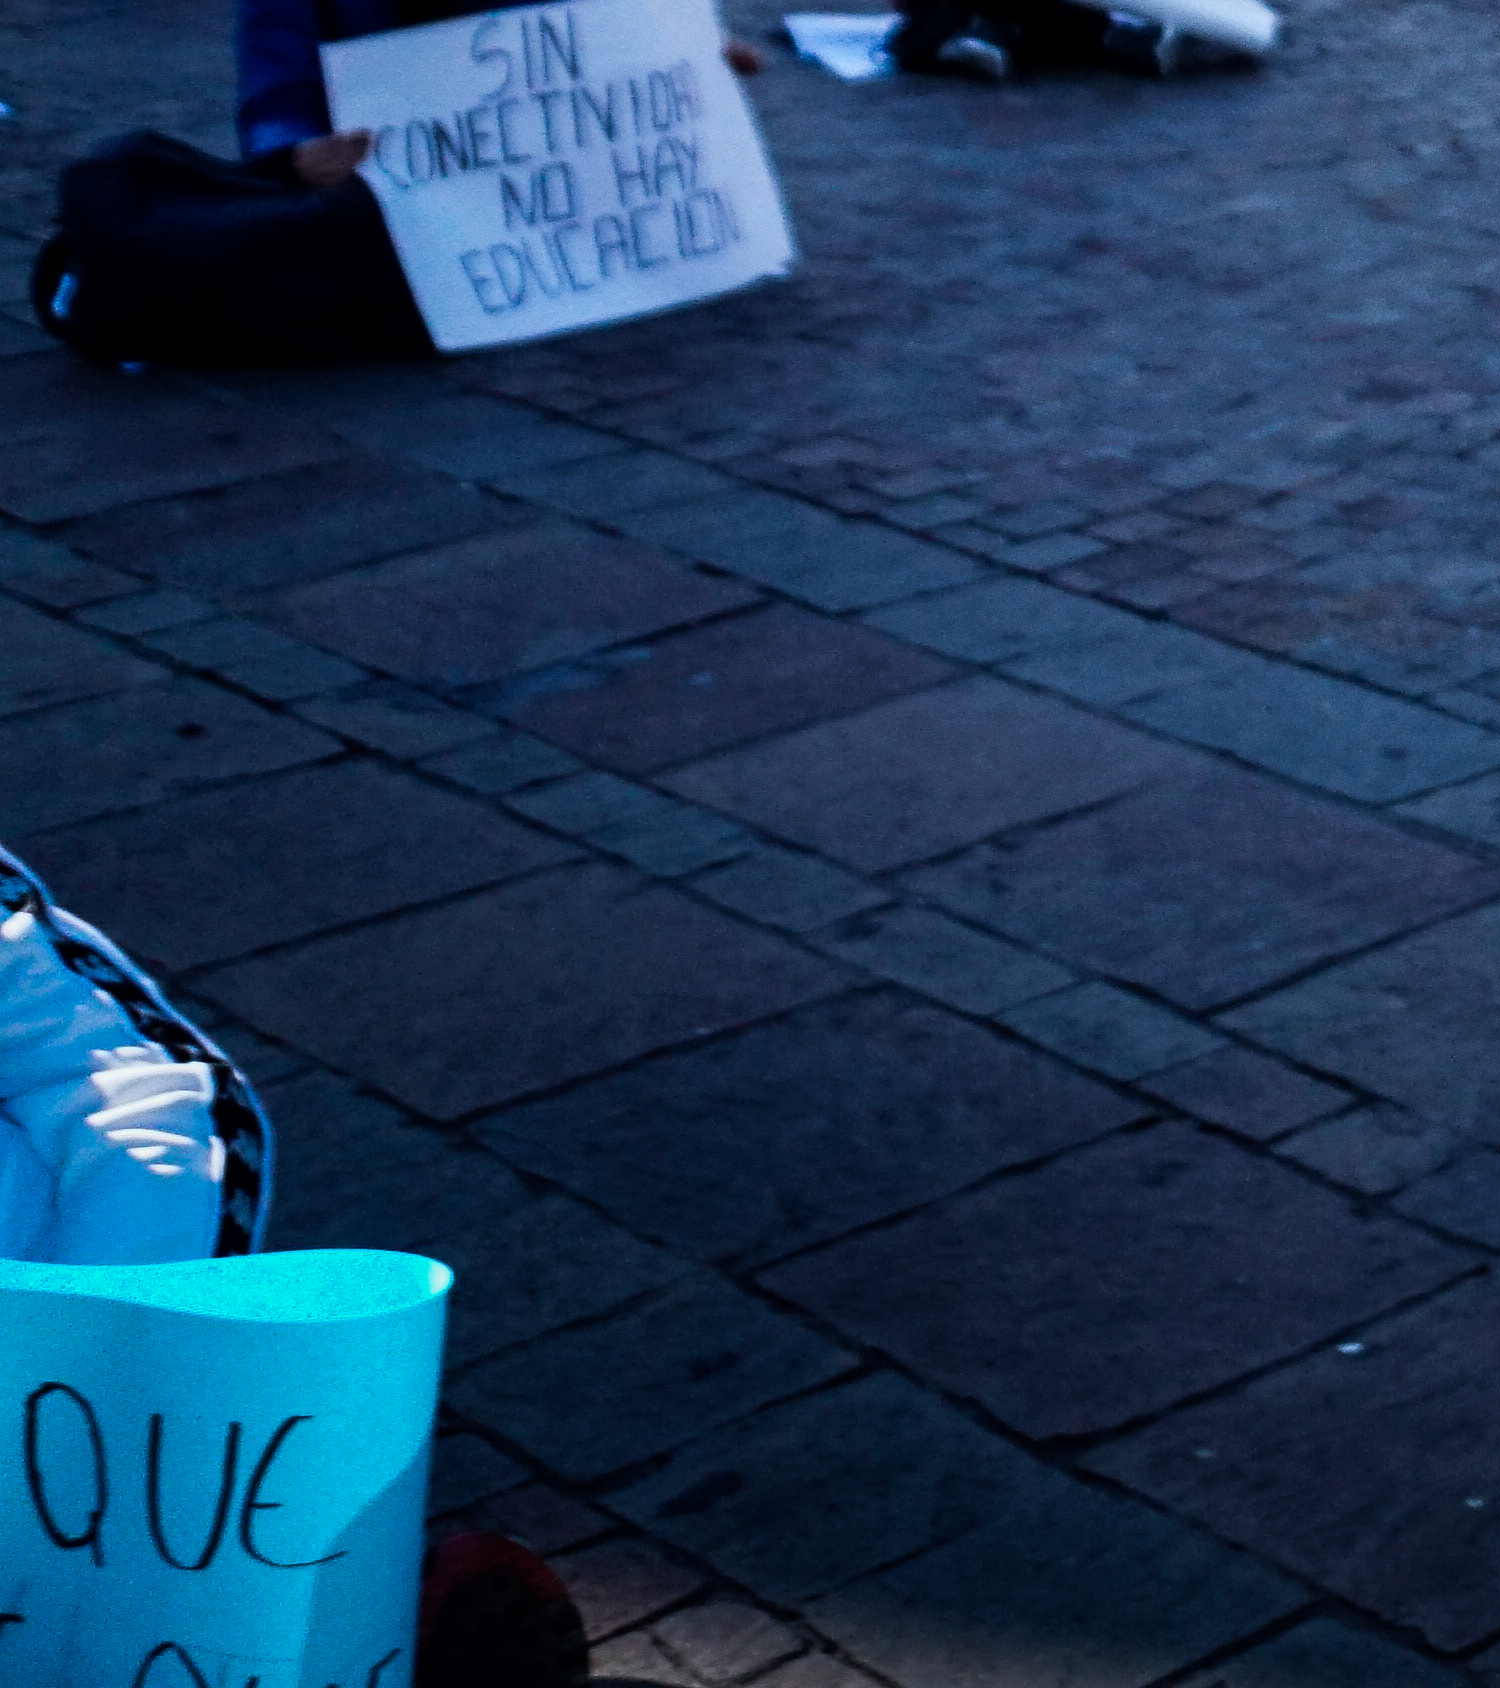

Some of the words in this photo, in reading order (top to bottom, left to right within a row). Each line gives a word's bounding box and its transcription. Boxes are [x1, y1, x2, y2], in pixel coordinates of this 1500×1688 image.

[471, 9, 583, 104] SIN
[501, 160, 579, 230] NO
[610, 135, 699, 208] HAY
[24, 1381, 350, 1571] QUE
